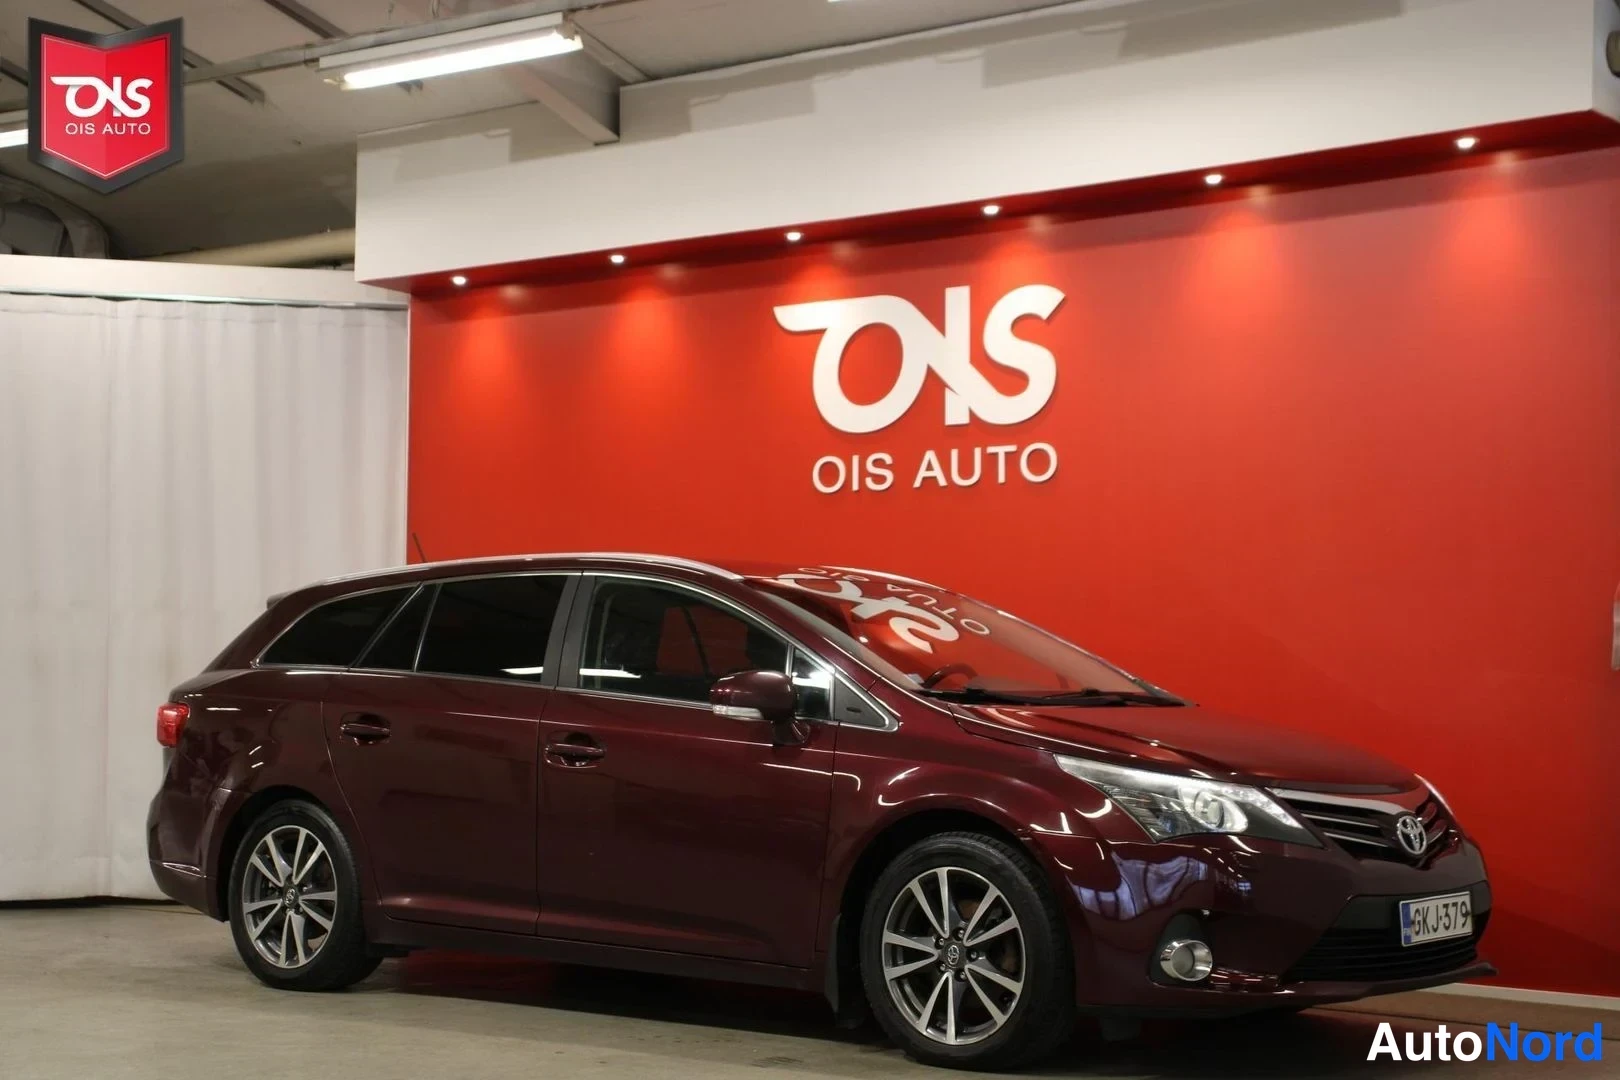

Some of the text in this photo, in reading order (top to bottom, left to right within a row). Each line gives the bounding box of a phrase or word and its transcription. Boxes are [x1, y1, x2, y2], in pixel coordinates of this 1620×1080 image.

[772, 284, 1066, 433] OIS
[812, 442, 1058, 494] OIS AUTO
[1413, 901, 1468, 936] GKJ-379
